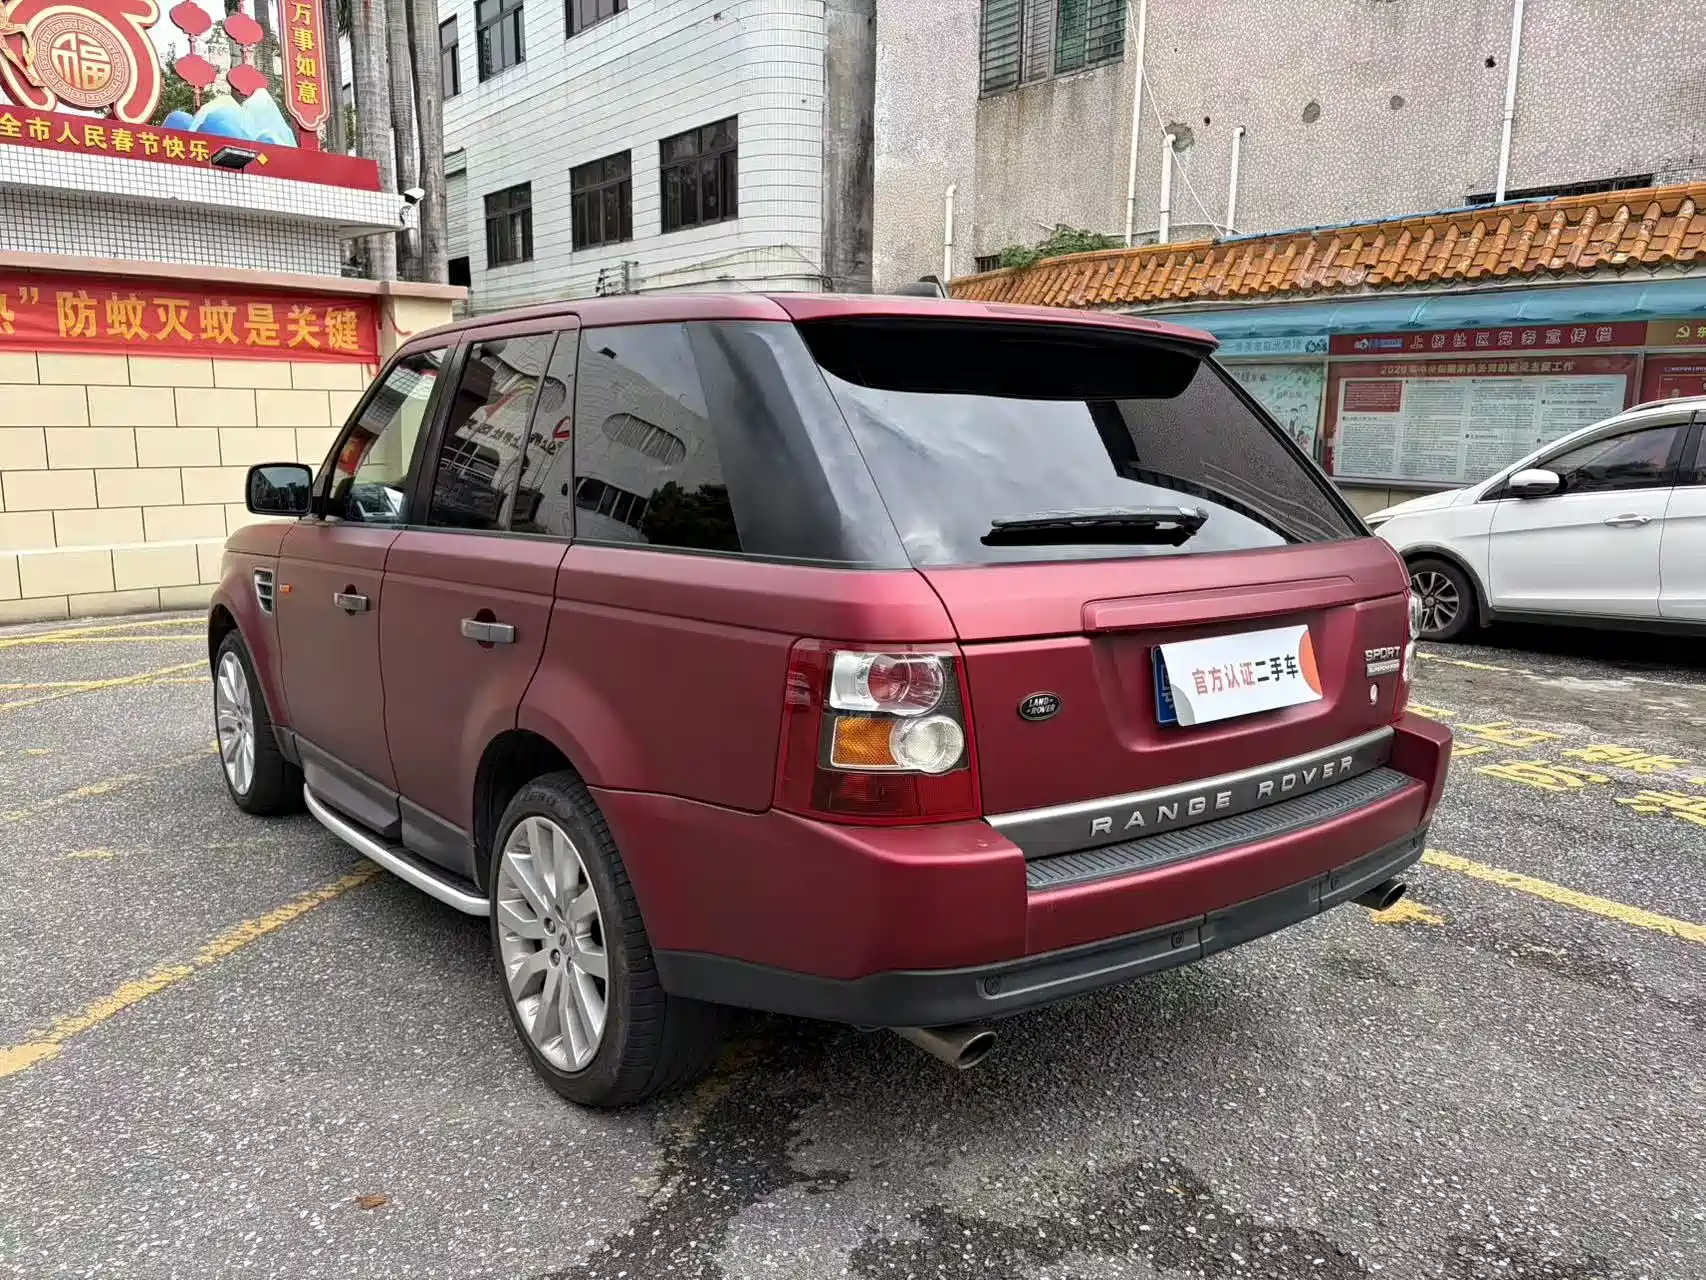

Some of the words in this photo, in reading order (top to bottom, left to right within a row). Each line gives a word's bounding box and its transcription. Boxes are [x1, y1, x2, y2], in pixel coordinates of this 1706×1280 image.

[50, 32, 112, 90] 福
[291, 1, 318, 105] 万事如意
[0, 112, 210, 162] 全市人民春节快乐
[1191, 653, 1299, 696] 官方认证二手车
[1364, 646, 1401, 661] SPORT
[1029, 697, 1049, 708] LAND
[1030, 704, 1056, 715] ROVER
[1090, 790, 1232, 837] RANGE
[1256, 755, 1353, 800] ROVER
